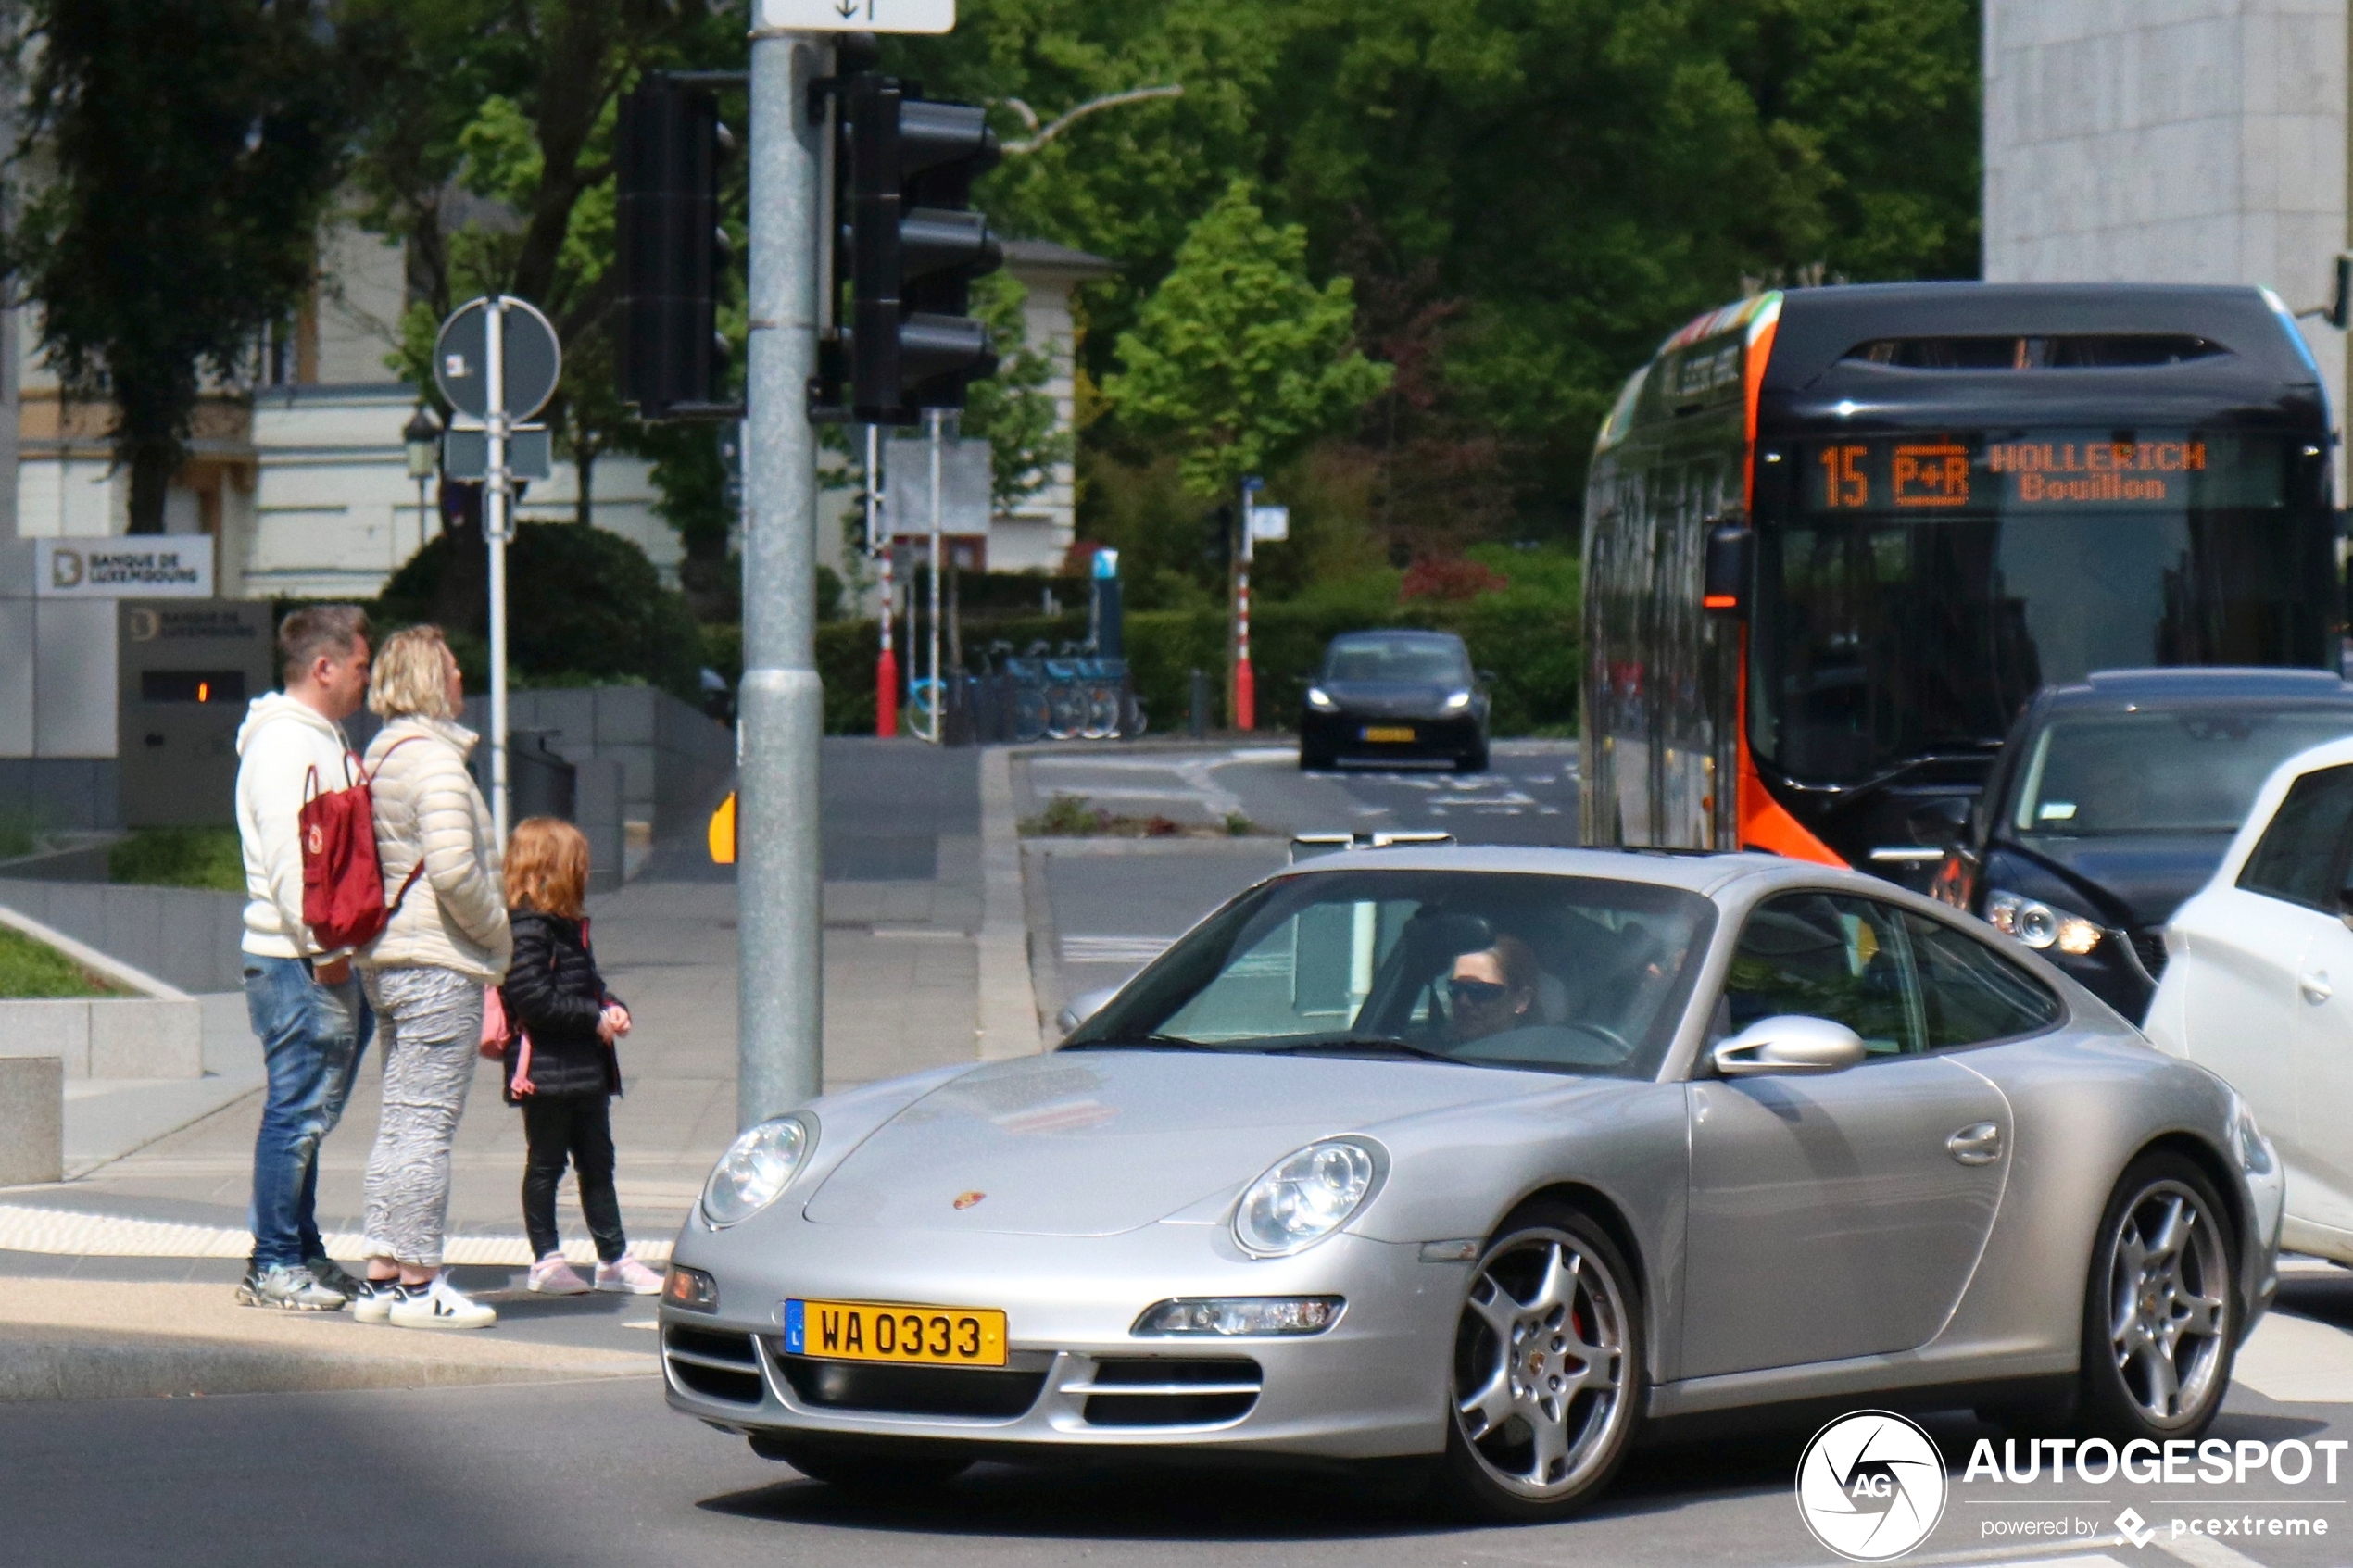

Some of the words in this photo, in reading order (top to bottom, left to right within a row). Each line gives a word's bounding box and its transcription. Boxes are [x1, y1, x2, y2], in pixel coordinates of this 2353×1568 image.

[1820, 446, 1868, 508] 15
[1892, 455, 1969, 496] P+R
[1990, 443, 2206, 472] HOLLERICH
[2019, 472, 2166, 501] Bouillon
[89, 553, 154, 568] BANQUE
[159, 553, 179, 568] DE
